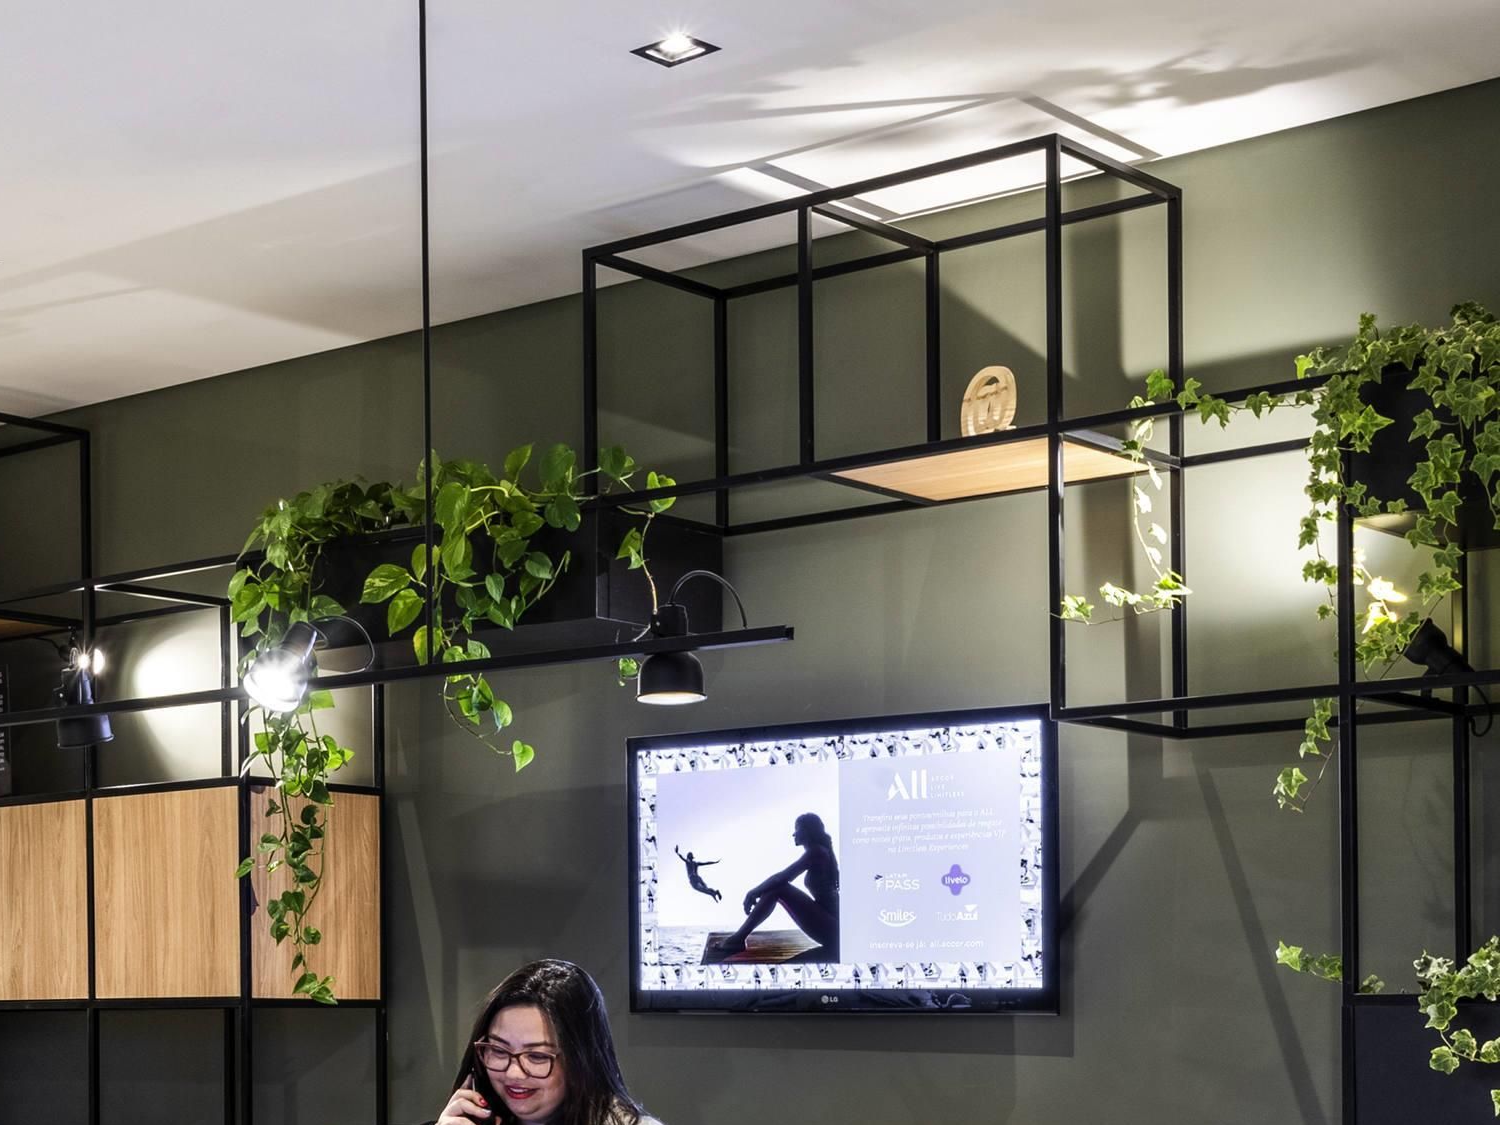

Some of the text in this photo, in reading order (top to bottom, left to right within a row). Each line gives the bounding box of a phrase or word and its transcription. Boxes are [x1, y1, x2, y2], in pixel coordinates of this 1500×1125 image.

[886, 769, 927, 801] All
[885, 879, 920, 890] PASS
[879, 908, 916, 922] Smiles
